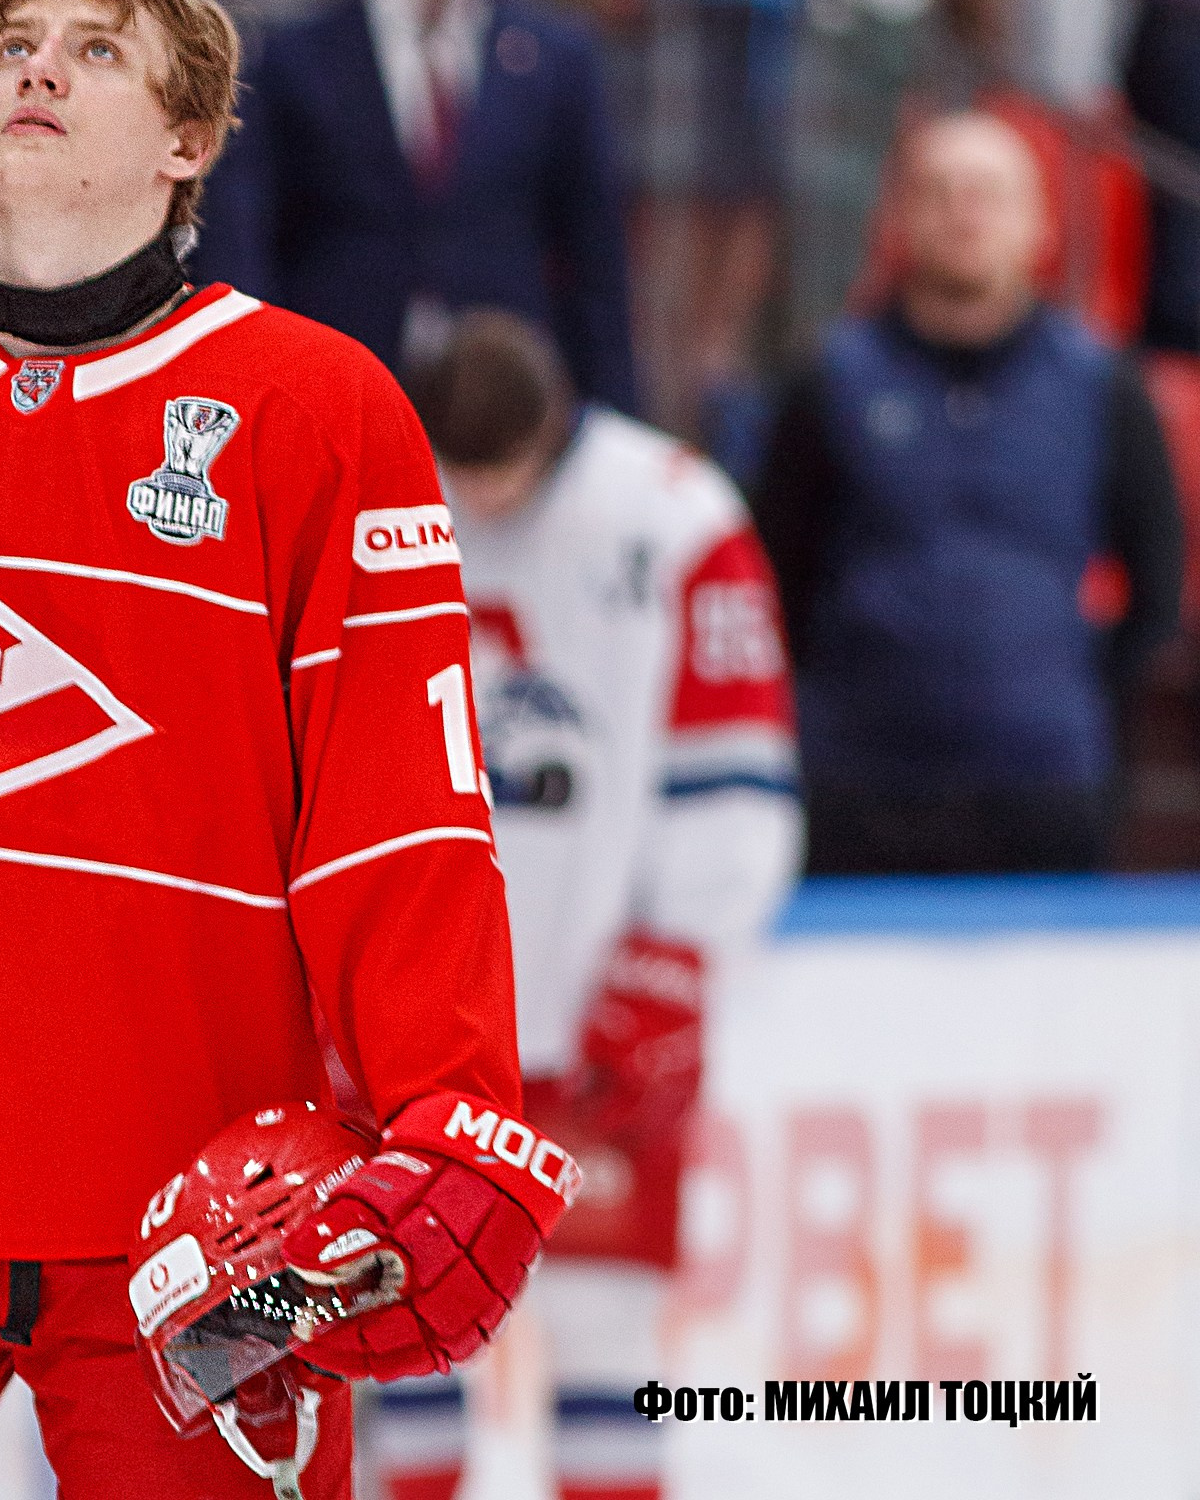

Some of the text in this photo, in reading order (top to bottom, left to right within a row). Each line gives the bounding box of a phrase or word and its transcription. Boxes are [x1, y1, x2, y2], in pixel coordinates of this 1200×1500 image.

[132, 484, 222, 533] ФИНАЛ
[364, 520, 457, 553] OLIM
[427, 662, 495, 813] 1
